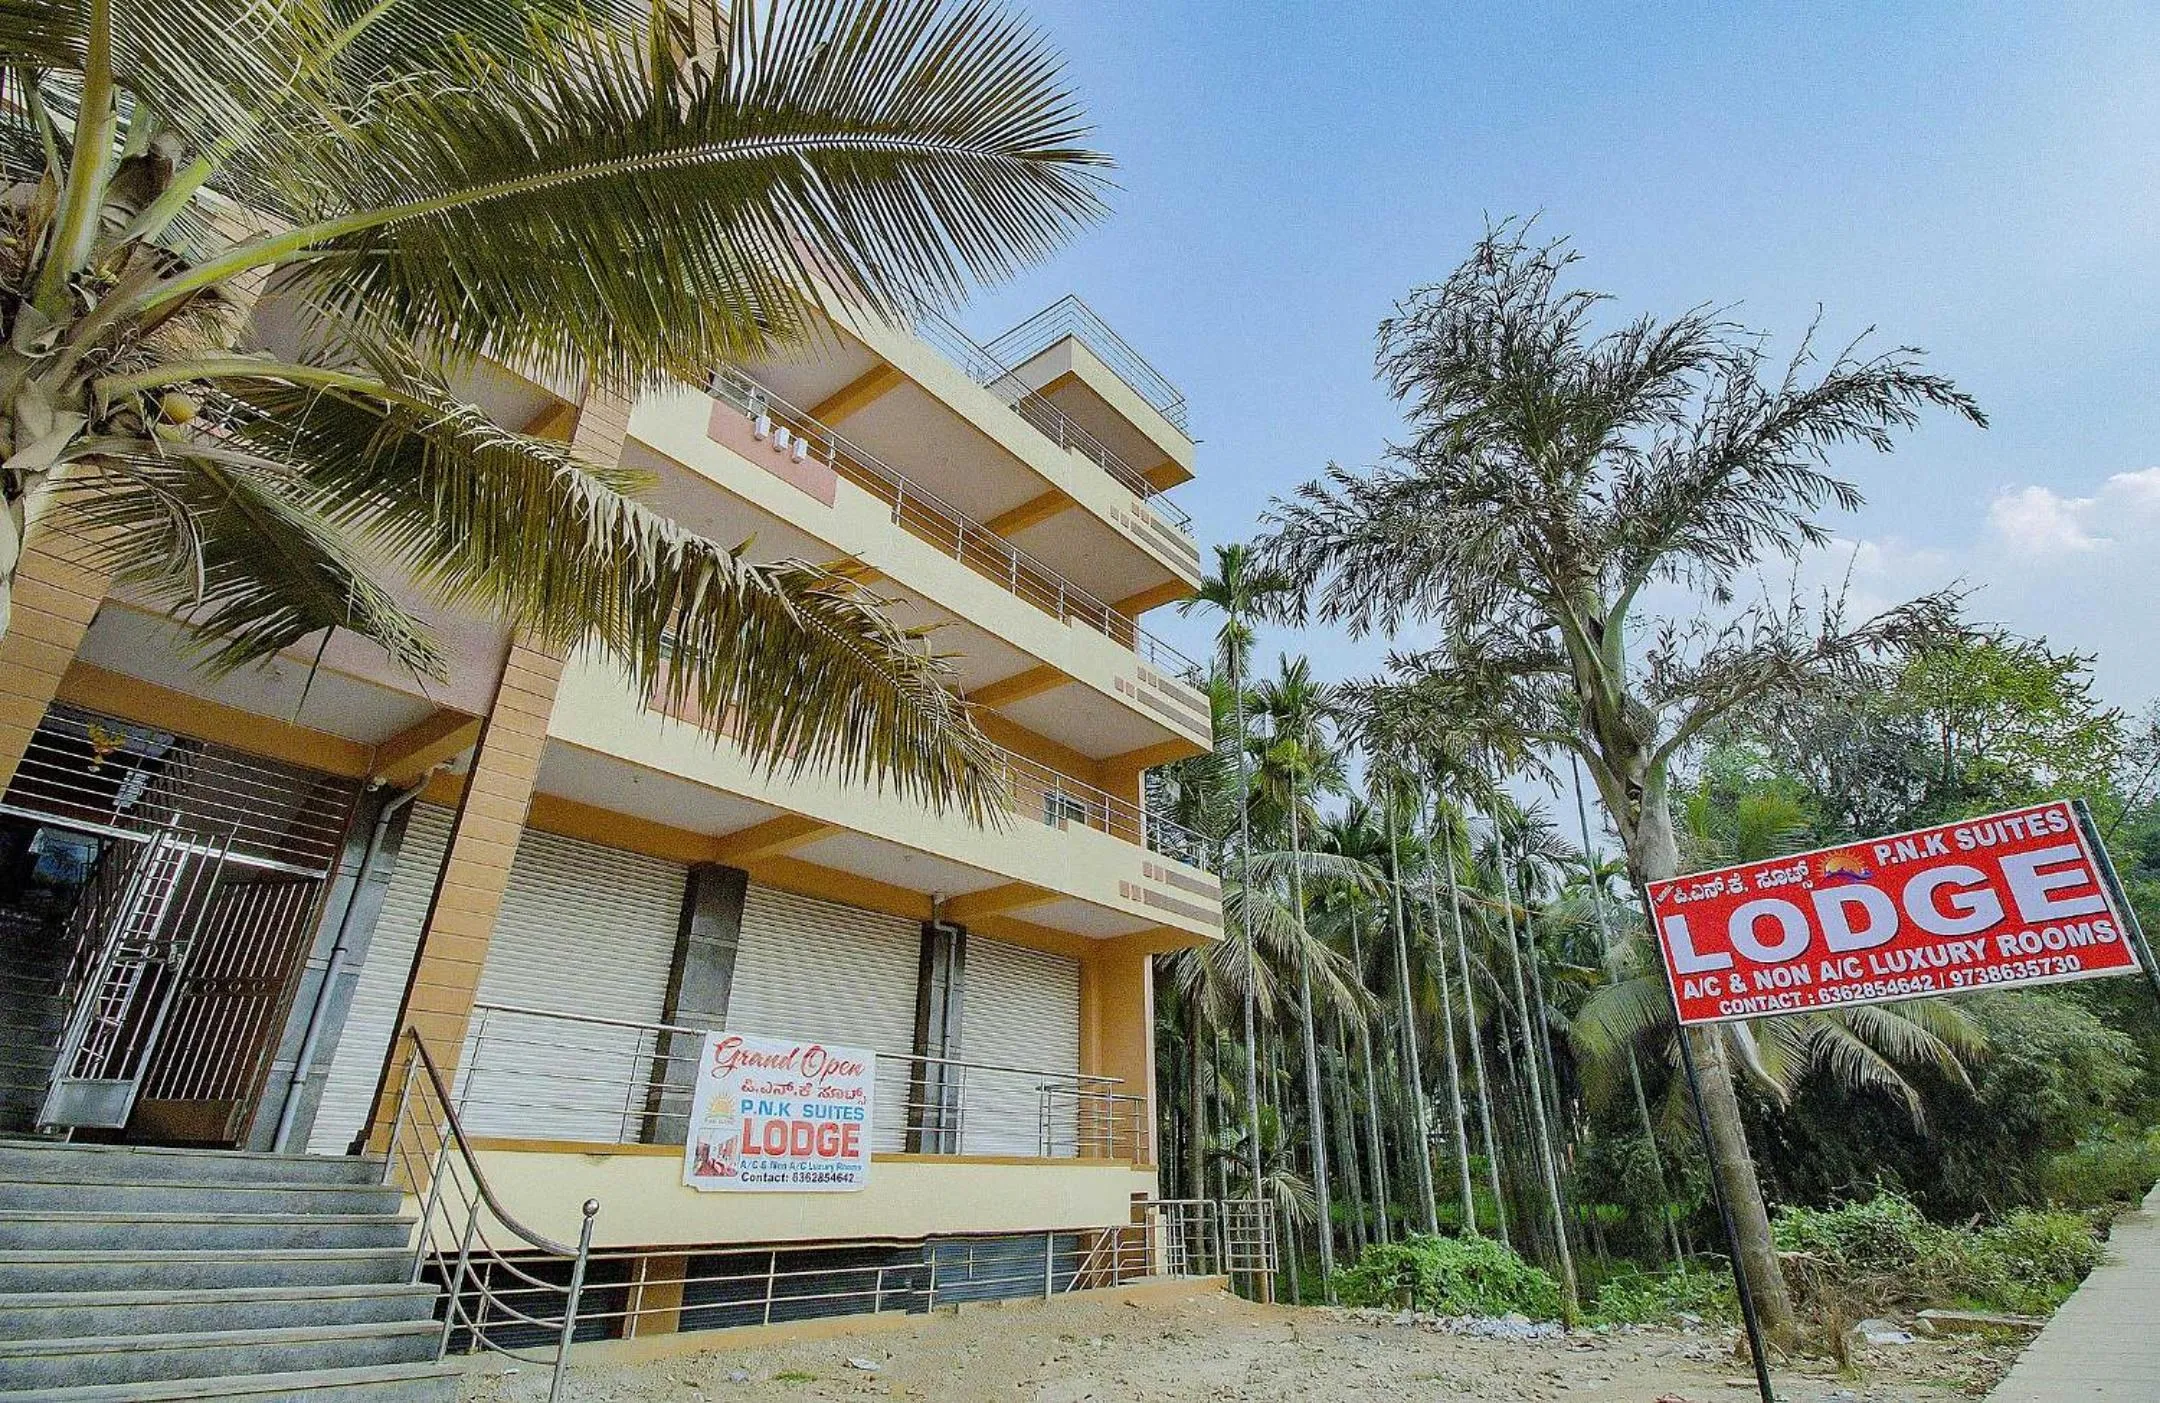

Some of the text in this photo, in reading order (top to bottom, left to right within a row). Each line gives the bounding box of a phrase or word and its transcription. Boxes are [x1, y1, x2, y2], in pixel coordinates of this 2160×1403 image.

[1874, 809, 2069, 868] P.N.K SUITES
[1664, 844, 2109, 975] LODGE
[1684, 919, 2117, 1000] A/C & NON A/C LUXURY ROOMS
[1719, 991, 1802, 1015] CONTACT
[1818, 973, 1935, 1004] 6362854642
[1949, 955, 2081, 987] 9738635730
[712, 1036, 865, 1084] Grand Open
[740, 1099, 865, 1121] P.N.K SUITES
[741, 1118, 861, 1158] LODGE
[741, 1172, 790, 1184] Contact:
